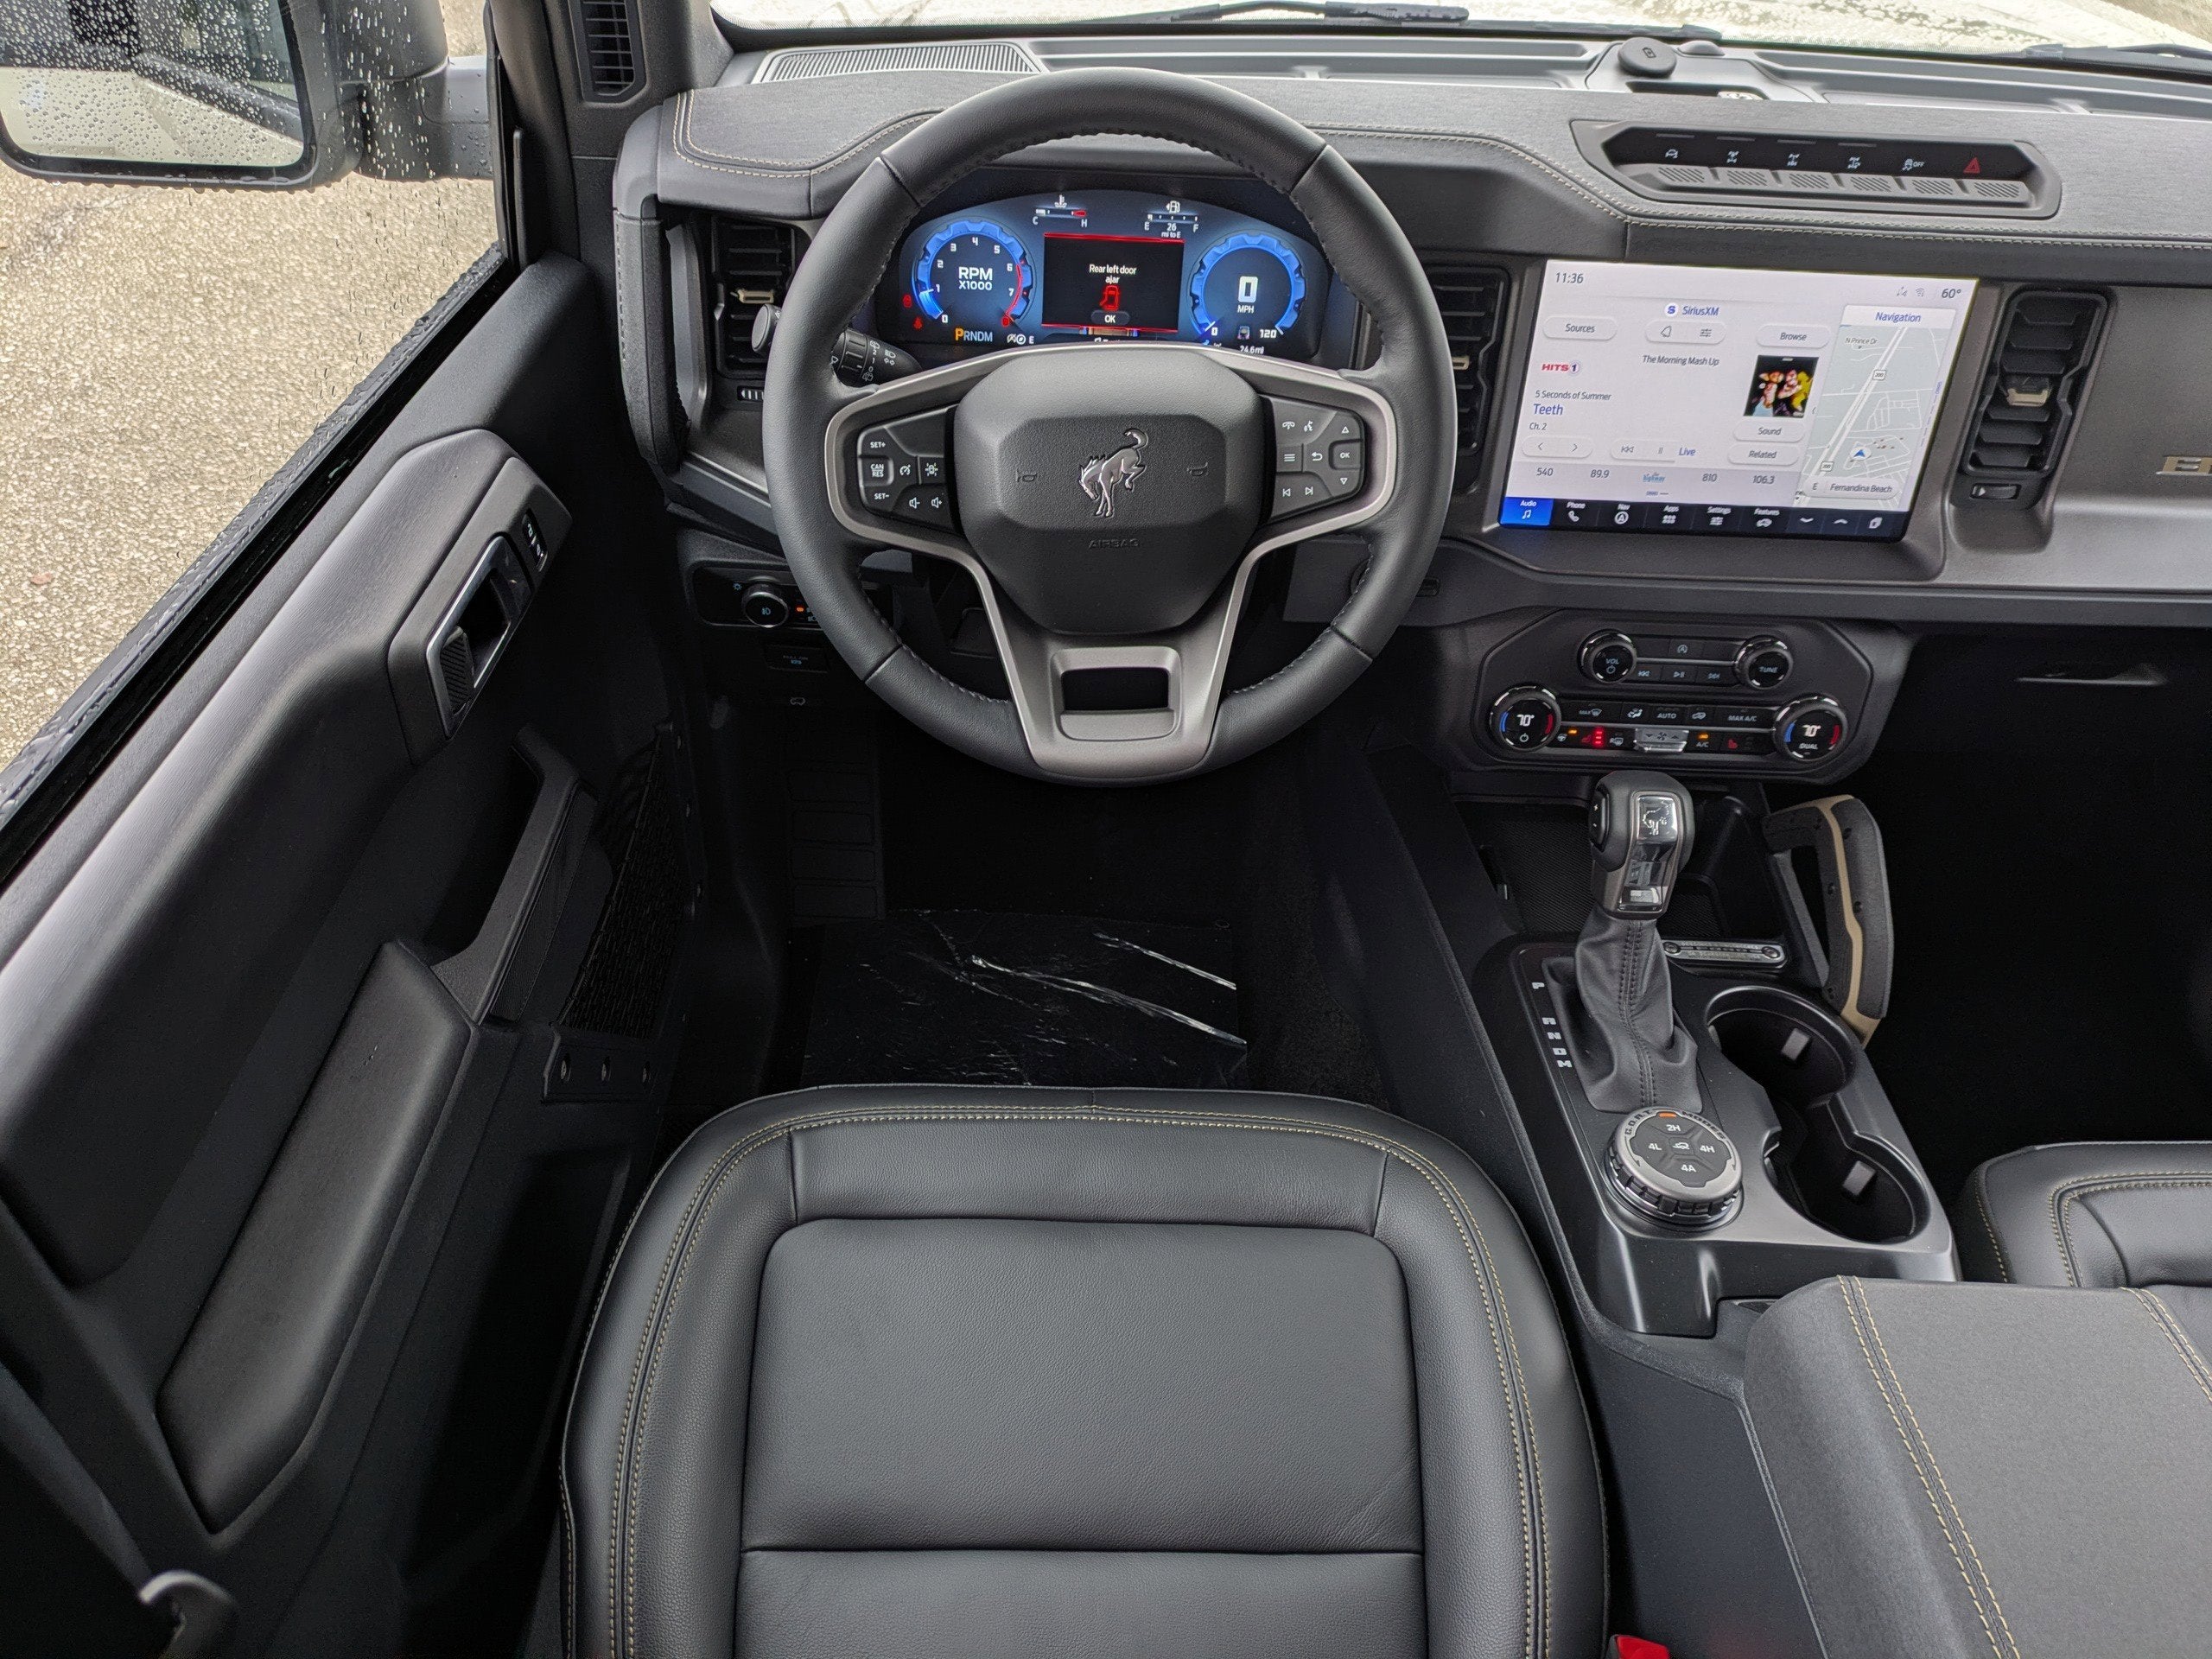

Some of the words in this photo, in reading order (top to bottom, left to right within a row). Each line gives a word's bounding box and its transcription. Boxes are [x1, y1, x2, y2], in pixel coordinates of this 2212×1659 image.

[1144, 222, 1149, 231] E
[1193, 224, 1198, 233] F
[972, 237, 978, 245] 4
[950, 243, 957, 251] 3
[994, 245, 1000, 254] 5
[937, 260, 944, 269] 2
[1090, 264, 1106, 273] Rear
[1107, 264, 1119, 274] left
[1120, 265, 1136, 274] door
[958, 267, 993, 281] RPM
[1556, 272, 1584, 284] 11:36
[1105, 276, 1120, 284] ajar
[958, 280, 993, 290] X1000
[1238, 276, 1259, 303] 0
[1941, 289, 1961, 299] 60°
[1237, 305, 1255, 314] MPH
[1682, 306, 1719, 316] SiriusXM
[942, 315, 948, 323] 0
[1104, 315, 1116, 323] OK
[1875, 312, 1922, 324] Navigation
[1211, 327, 1218, 336] 0
[1565, 323, 1596, 334] Sources
[1260, 329, 1277, 339] 120
[1780, 332, 1808, 341] Browse
[1643, 355, 1656, 364] The
[1657, 356, 1687, 365] Morning
[1688, 357, 1707, 365] Mash
[1708, 358, 1720, 366] Up
[1535, 390, 1541, 398] 5
[1541, 391, 1571, 399] Seconds
[1581, 392, 1611, 401] Summer
[1533, 404, 1563, 416] Teeth
[1529, 422, 1541, 430] Ch.
[1758, 427, 1783, 435] Sound
[1679, 447, 1696, 456] Live
[1748, 450, 1777, 459] Related
[1536, 467, 1554, 477] 540
[1590, 469, 1610, 479] 89.9
[1702, 474, 1718, 482] 810
[1753, 475, 1776, 485] 106.3
[1829, 483, 1870, 493] Fernandina
[1871, 485, 1893, 493] Beach
[1707, 506, 1732, 515] Settings
[1088, 537, 1141, 550] AIRBAG
[1553, 1047, 1567, 1056] D
[1681, 1110, 1726, 1140] MODES
[1699, 1145, 1715, 1154] 4H
[1681, 1164, 1697, 1173] 4A
